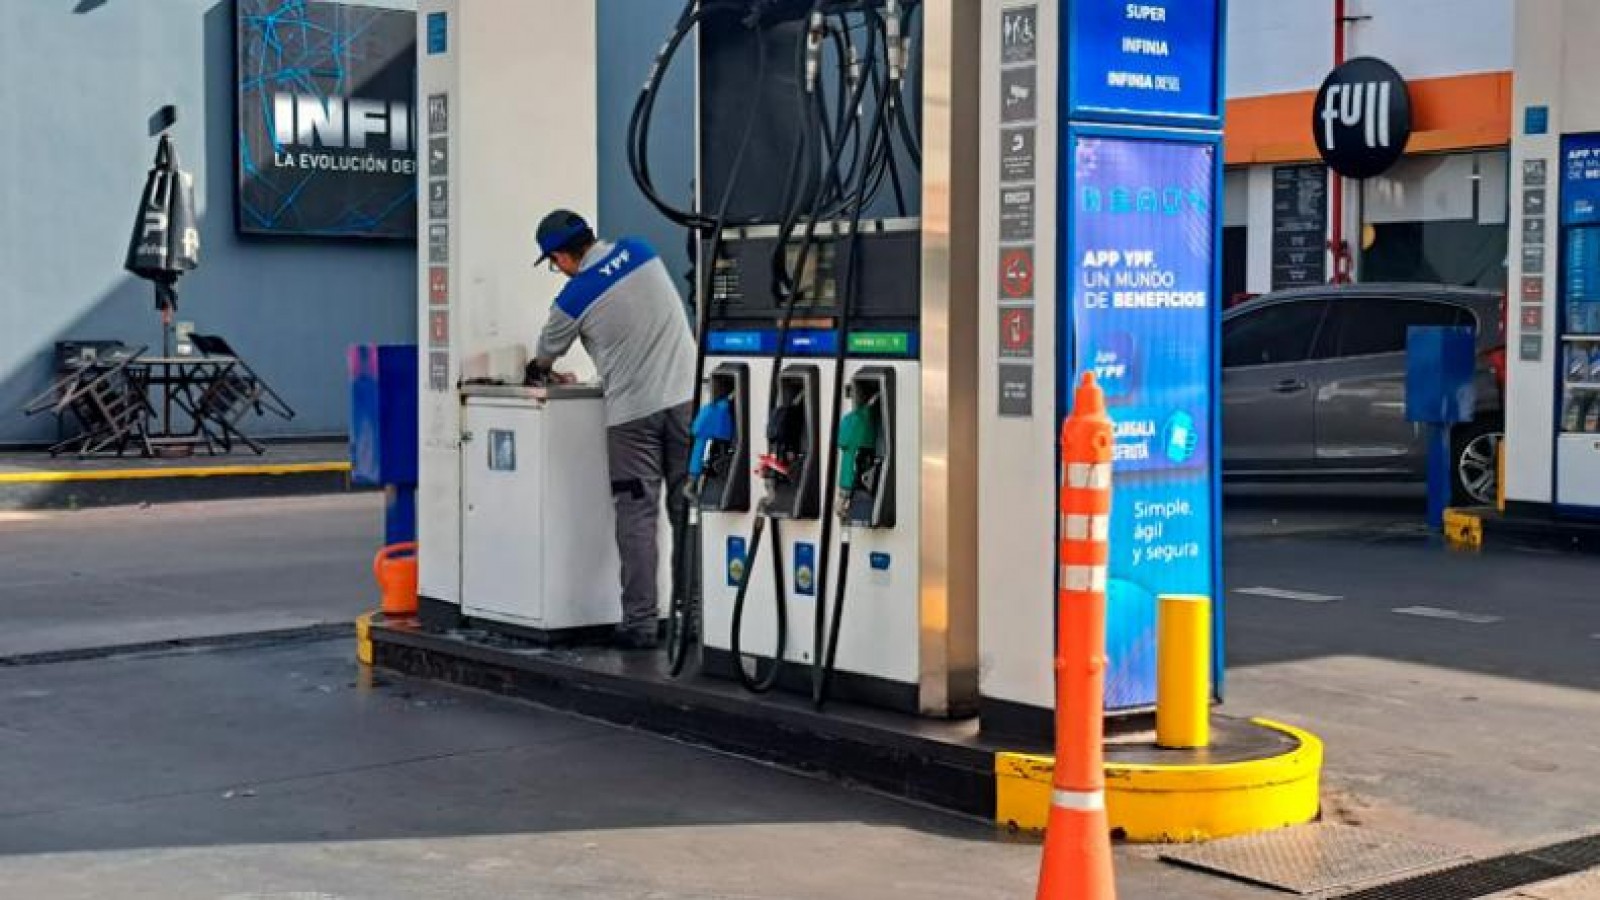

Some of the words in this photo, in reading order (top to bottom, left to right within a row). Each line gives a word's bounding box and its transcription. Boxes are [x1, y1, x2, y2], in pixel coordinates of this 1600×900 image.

[1126, 4, 1166, 22] SUPER
[1122, 36, 1169, 57] INFINIA
[1107, 71, 1153, 90] INFINIA
[274, 93, 416, 151] INFI
[1321, 81, 1391, 150] full
[274, 152, 295, 168] LA
[301, 154, 387, 172] EVOLUCIÓN
[598, 248, 630, 276] YPF
[1083, 251, 1119, 268] APP
[1084, 271, 1109, 288] UN
[1115, 272, 1174, 289] MUNDO
[1085, 292, 1109, 309] DE
[1113, 291, 1206, 309] BENEFICIOS
[1132, 547, 1142, 566] y
[1146, 544, 1199, 563] segura
